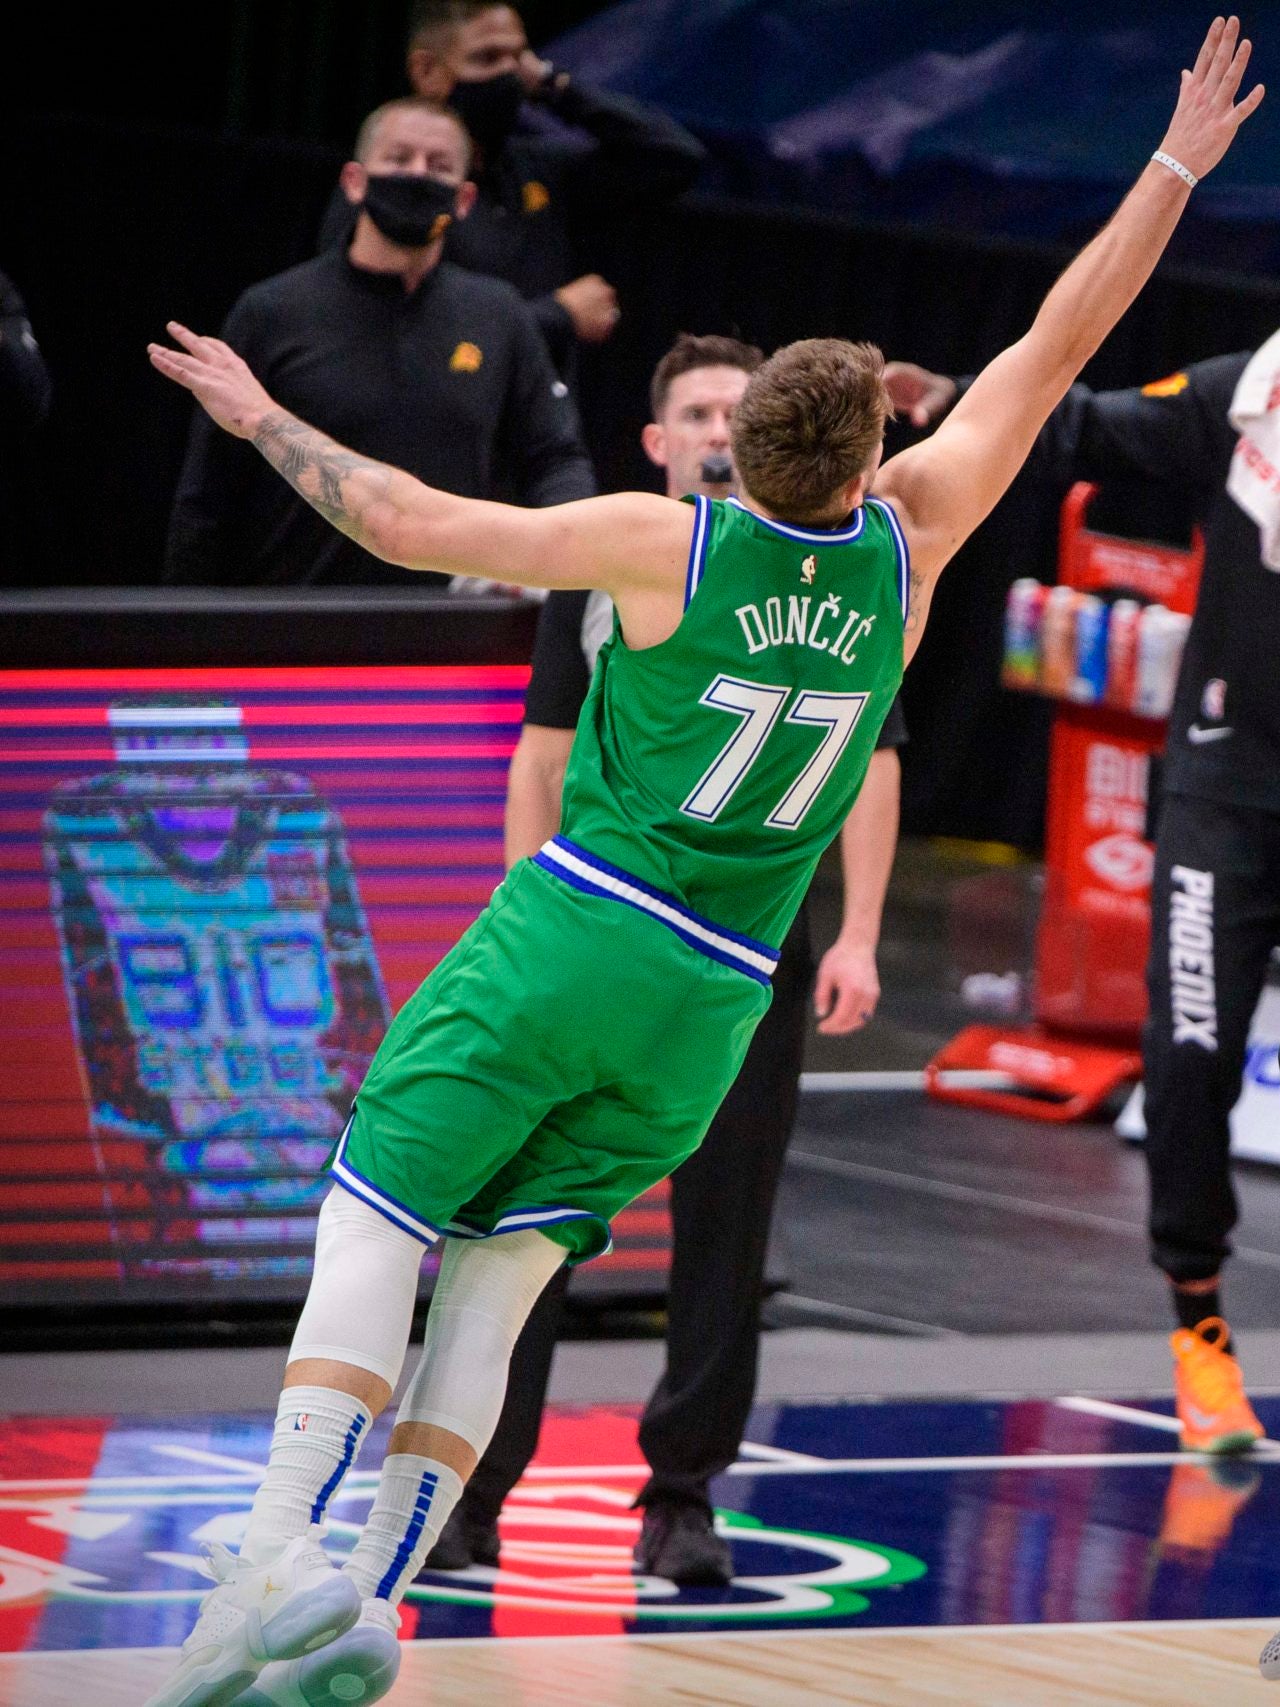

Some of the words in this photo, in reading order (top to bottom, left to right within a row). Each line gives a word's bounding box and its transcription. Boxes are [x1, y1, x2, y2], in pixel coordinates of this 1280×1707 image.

[735, 592, 876, 664] DONČIĆ
[679, 673, 871, 830] 77
[1169, 864, 1218, 1051] PHOENIX
